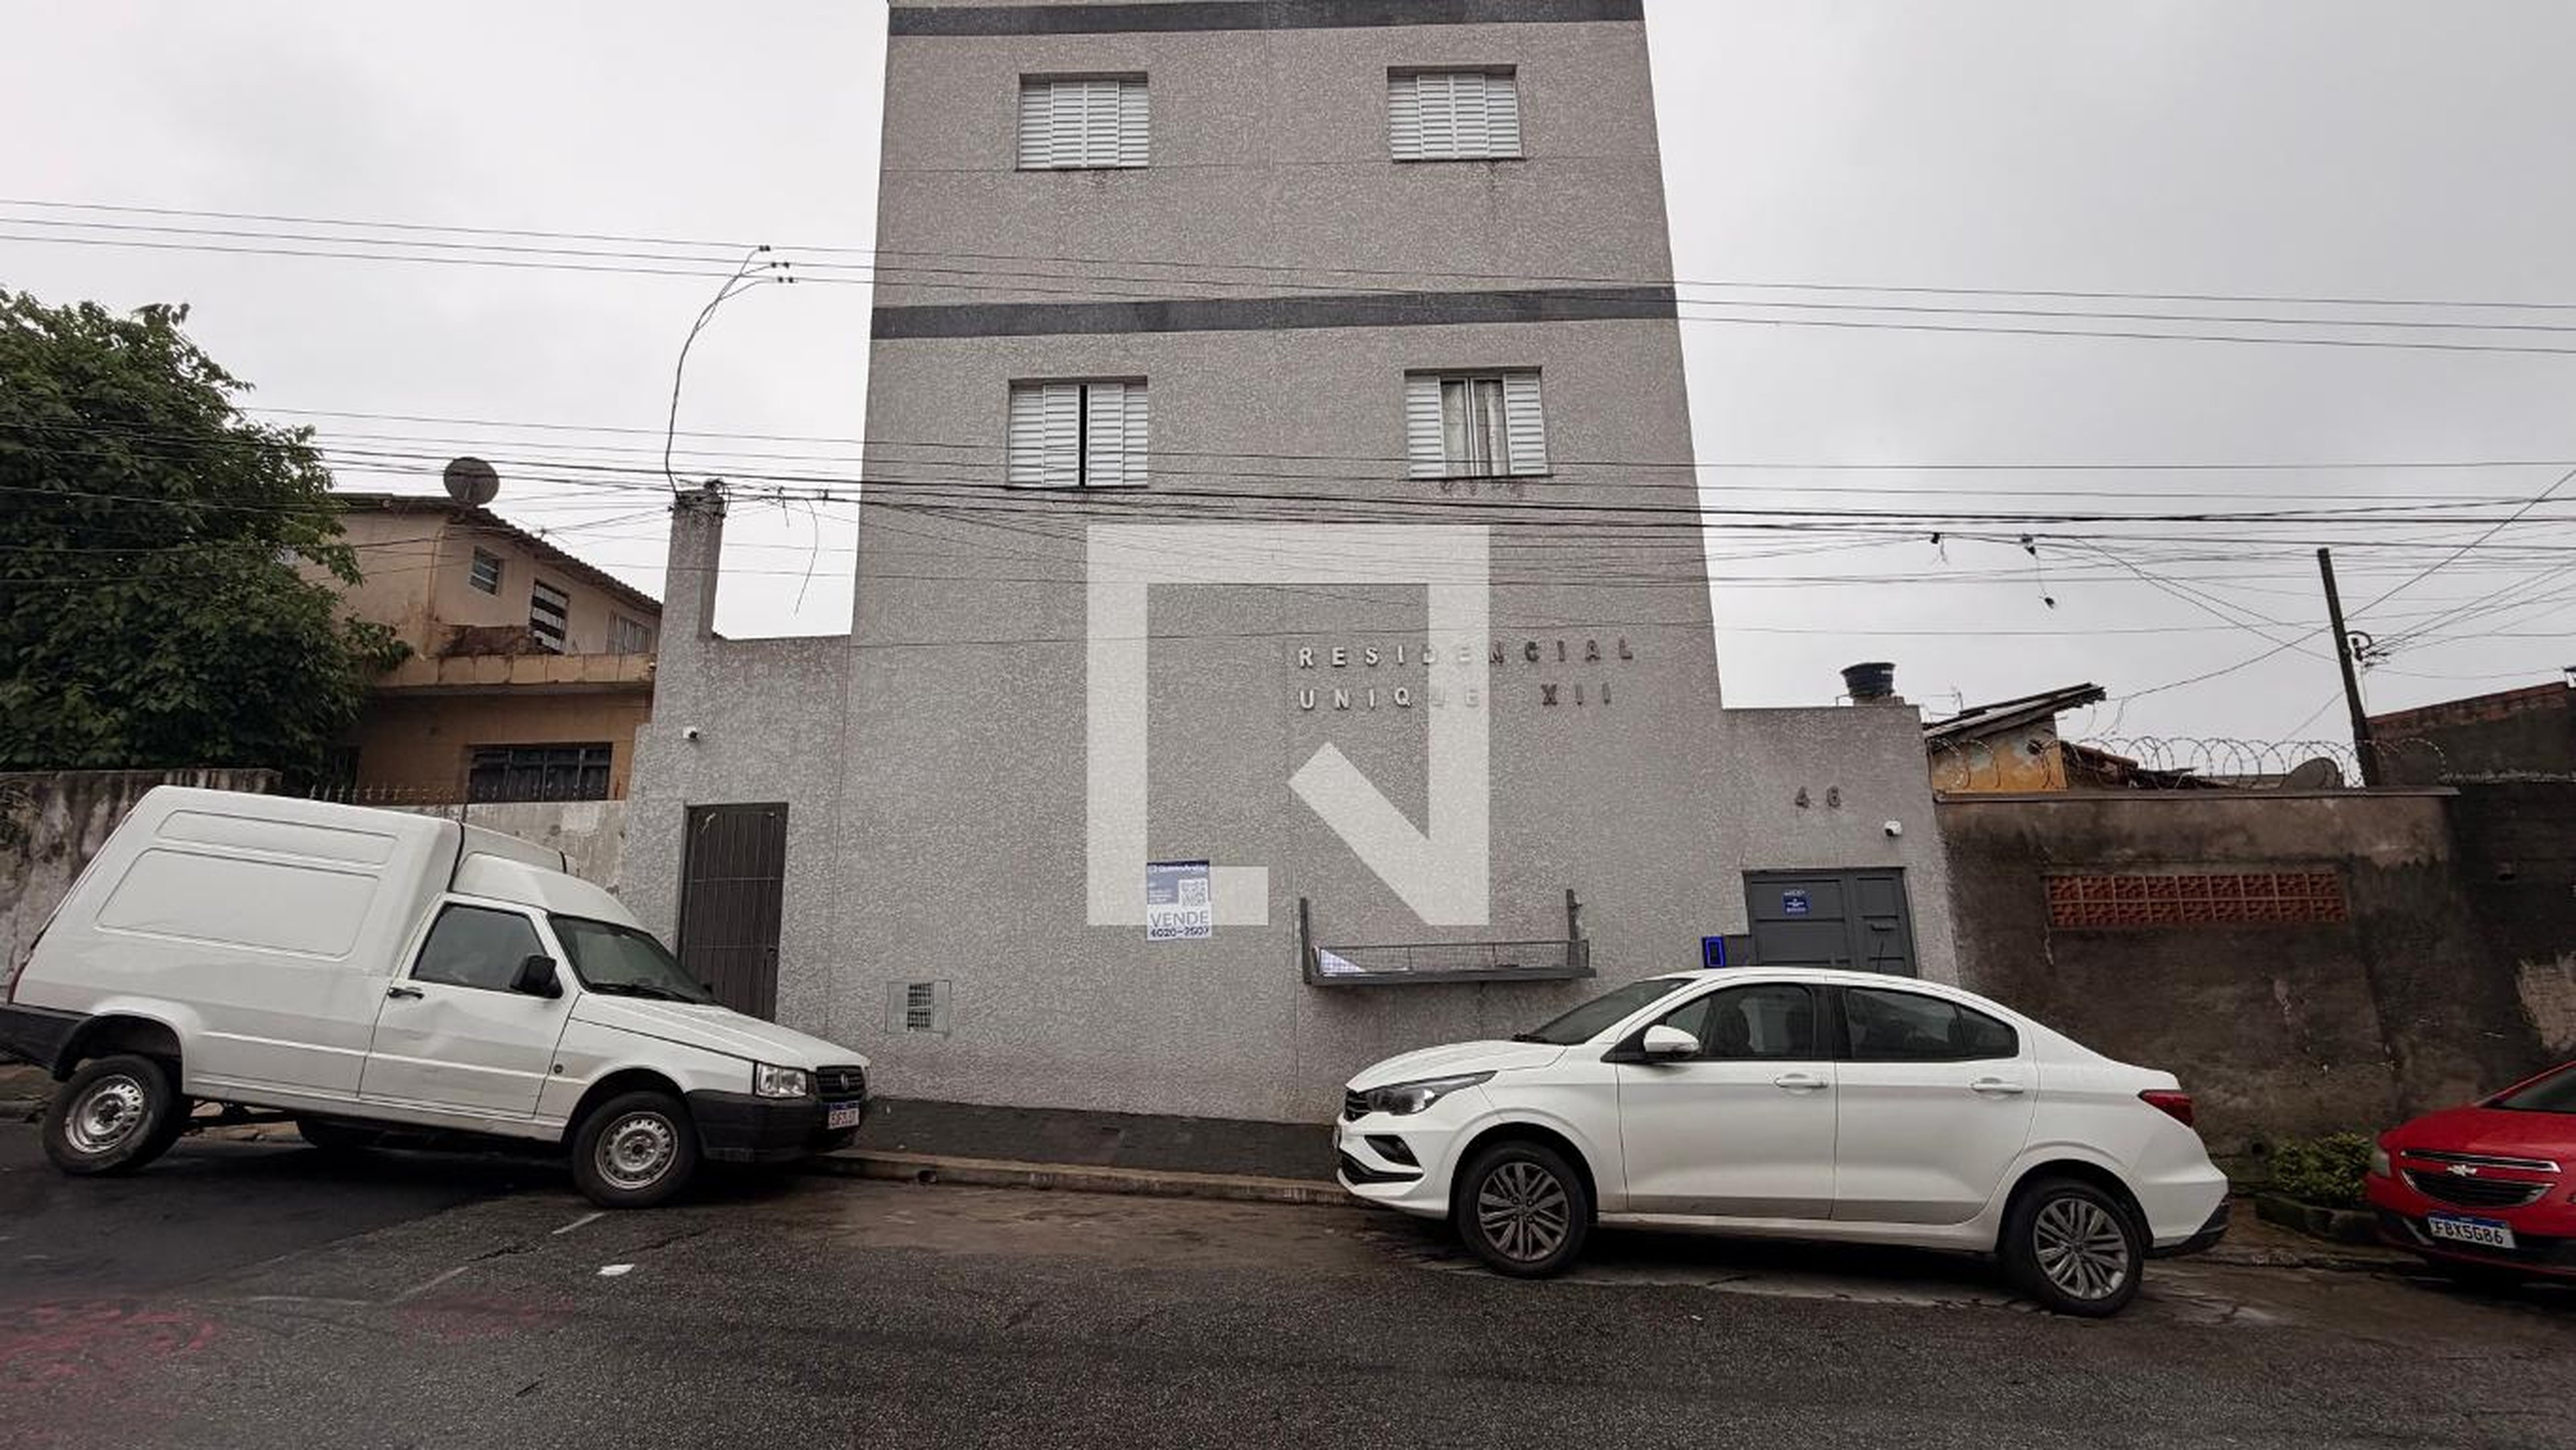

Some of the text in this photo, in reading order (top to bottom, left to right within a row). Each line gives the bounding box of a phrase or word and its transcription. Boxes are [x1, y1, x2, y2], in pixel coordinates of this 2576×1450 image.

[1299, 639, 1633, 668] RESIDENCIAL
[1299, 683, 1610, 710] UNIQUE XII
[1149, 911, 1210, 927] VENDE
